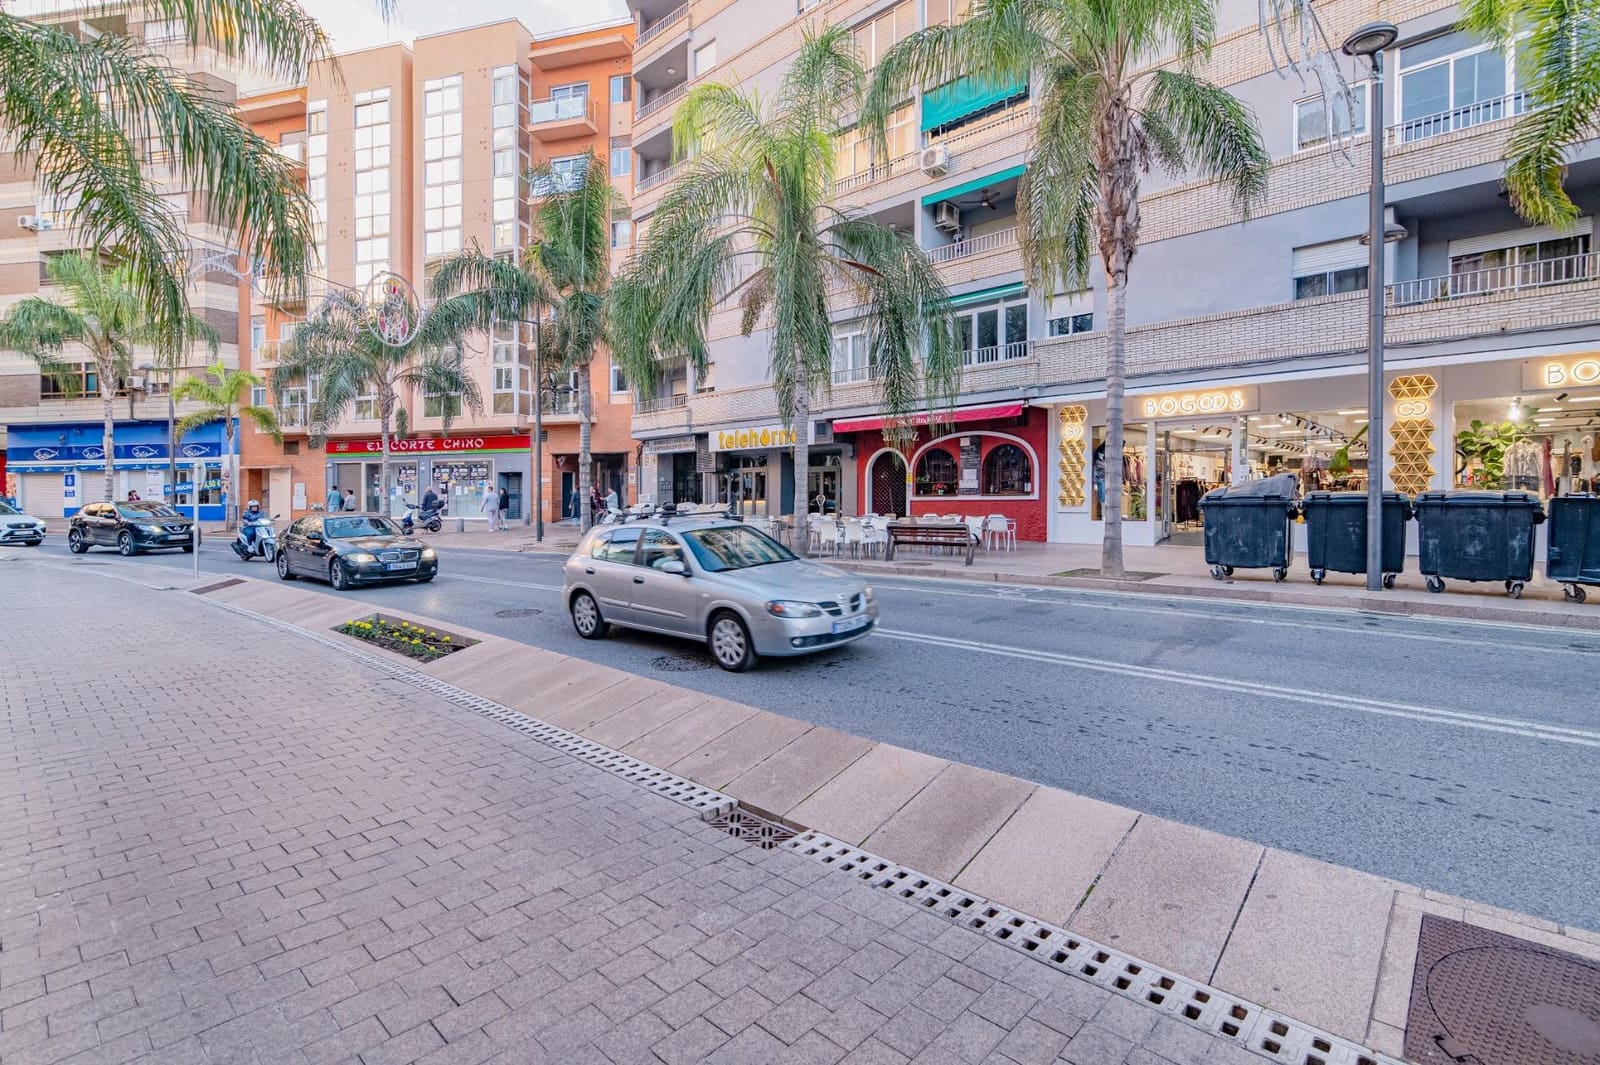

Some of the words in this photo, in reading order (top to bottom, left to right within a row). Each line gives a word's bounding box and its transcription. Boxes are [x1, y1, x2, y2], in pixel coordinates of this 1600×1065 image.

[367, 441, 383, 451] EL
[390, 439, 435, 450] CORTE
[442, 438, 484, 449] CHINO
